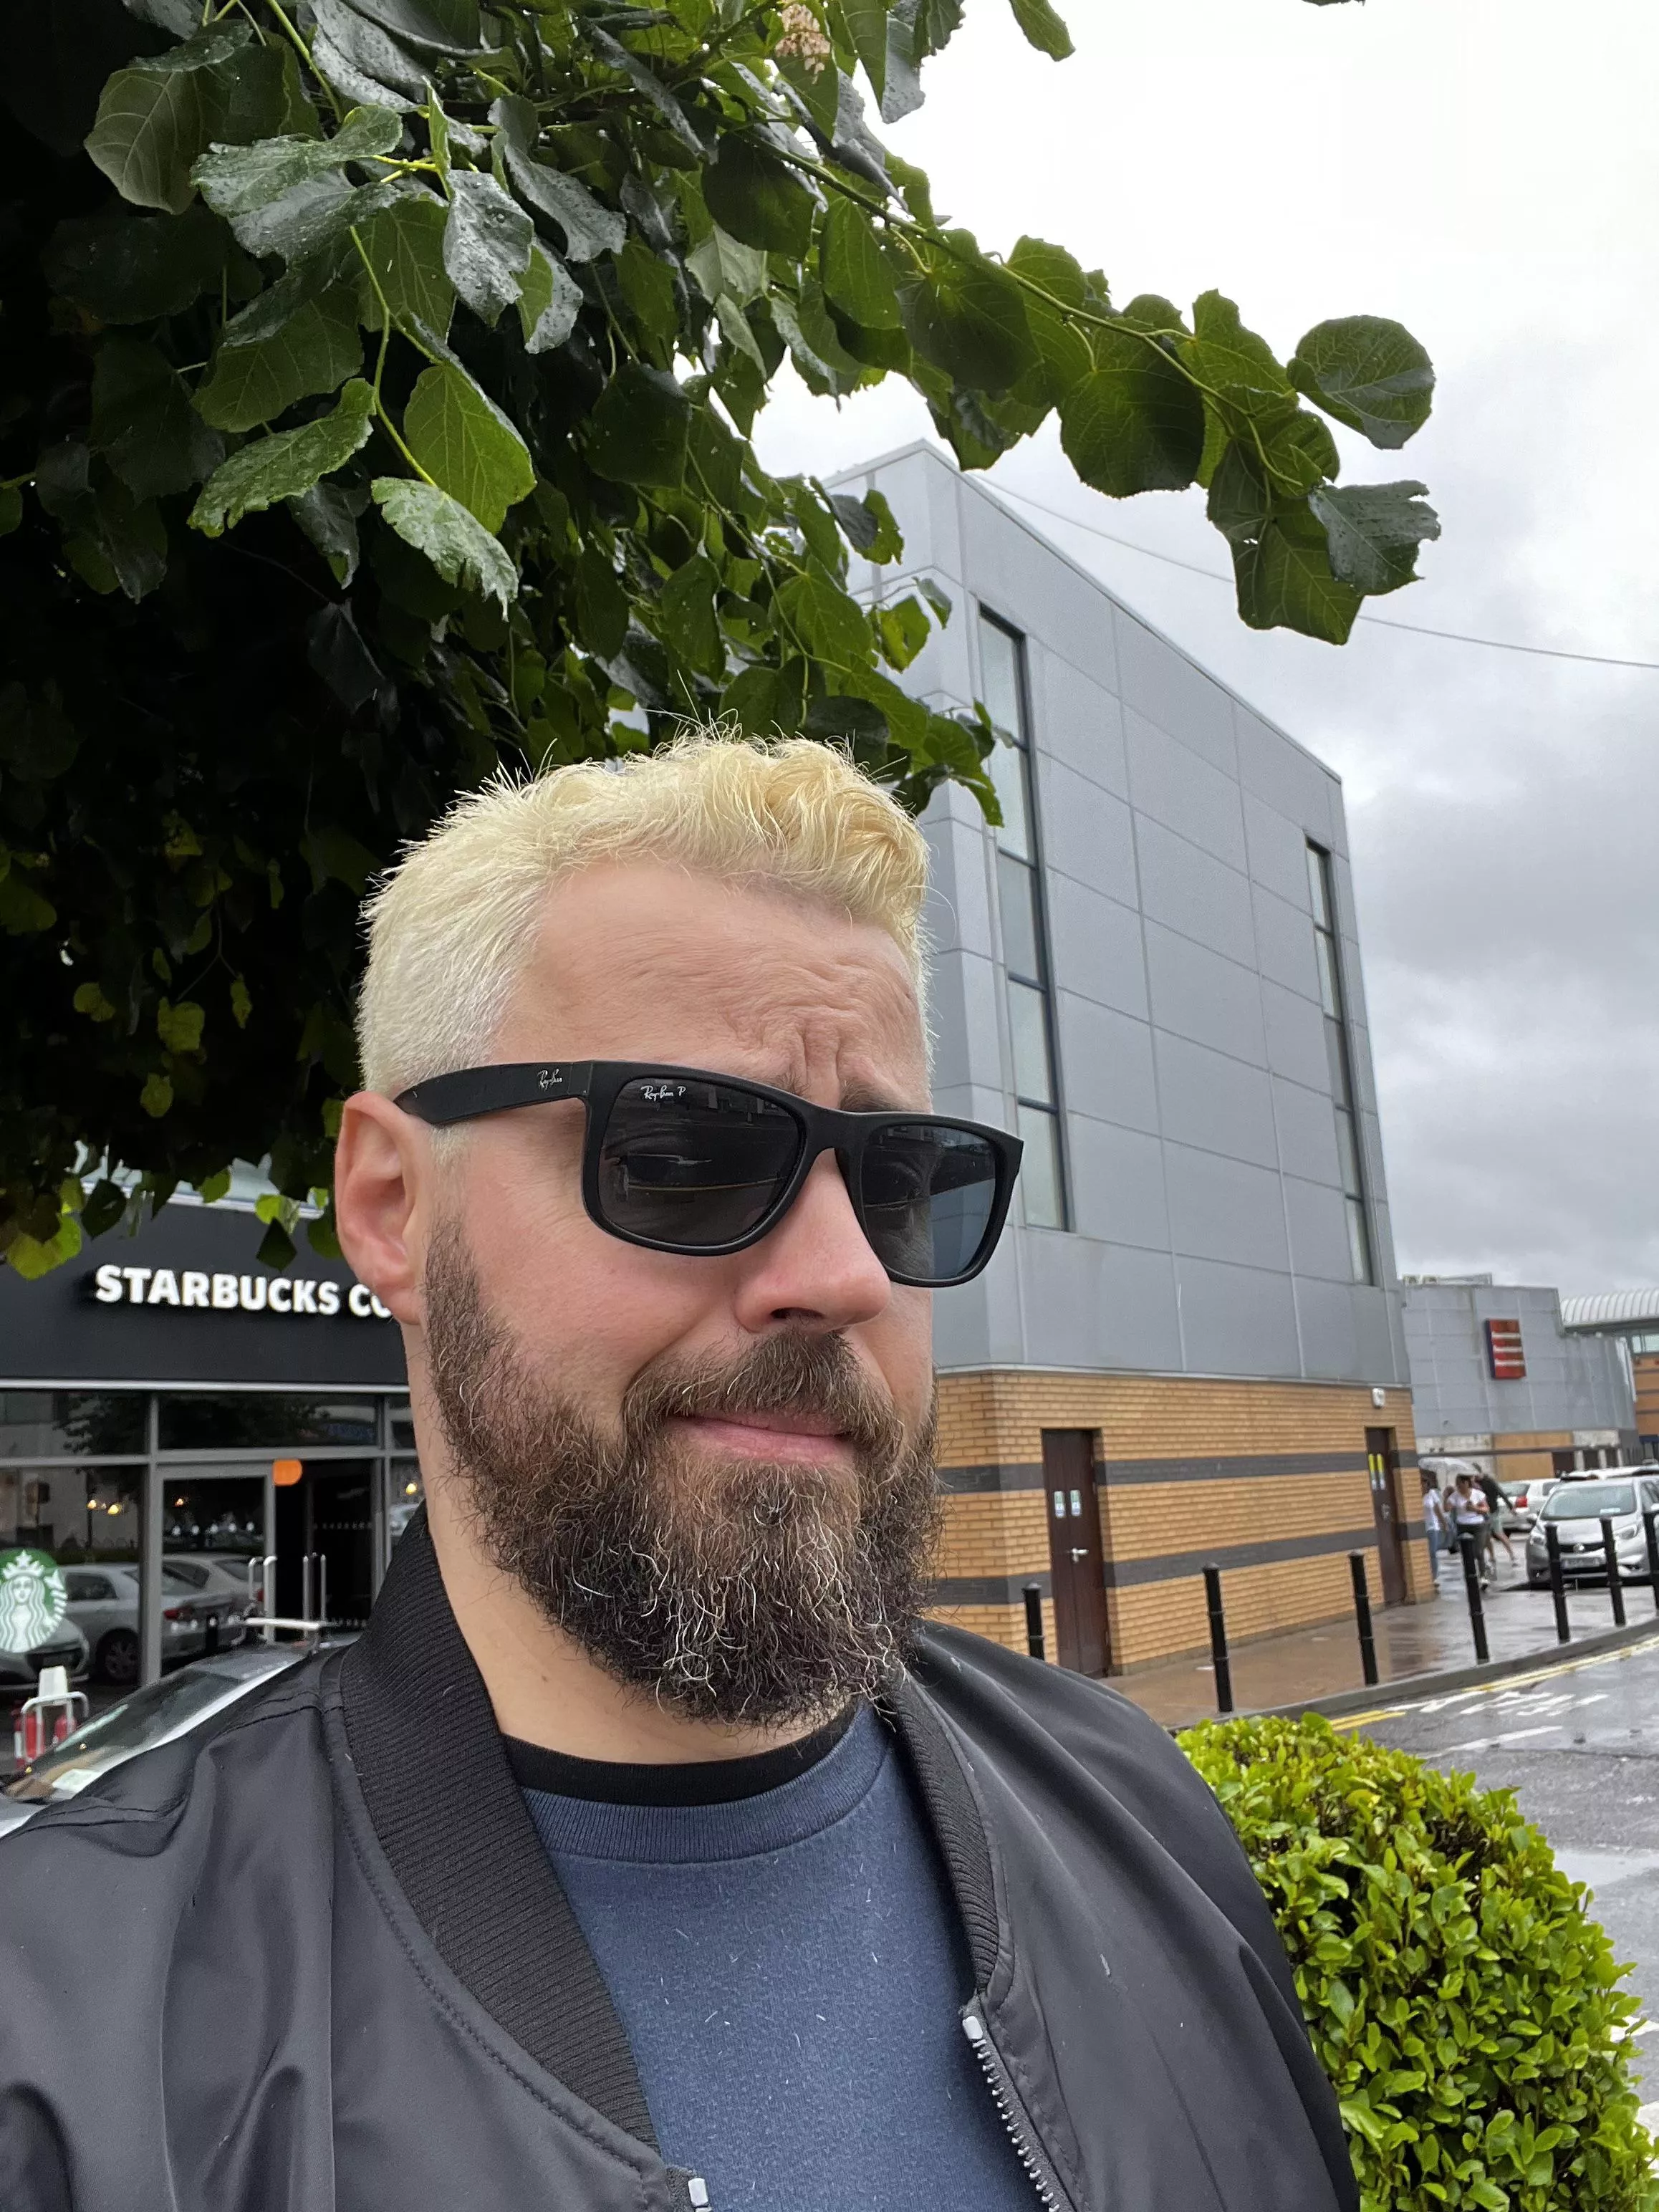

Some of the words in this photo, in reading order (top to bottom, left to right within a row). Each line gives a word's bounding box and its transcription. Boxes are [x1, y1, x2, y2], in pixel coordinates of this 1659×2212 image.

[640, 1085, 674, 1102] Ray-Ban
[677, 1085, 687, 1097] P
[95, 1264, 340, 1315] STARBUCKS
